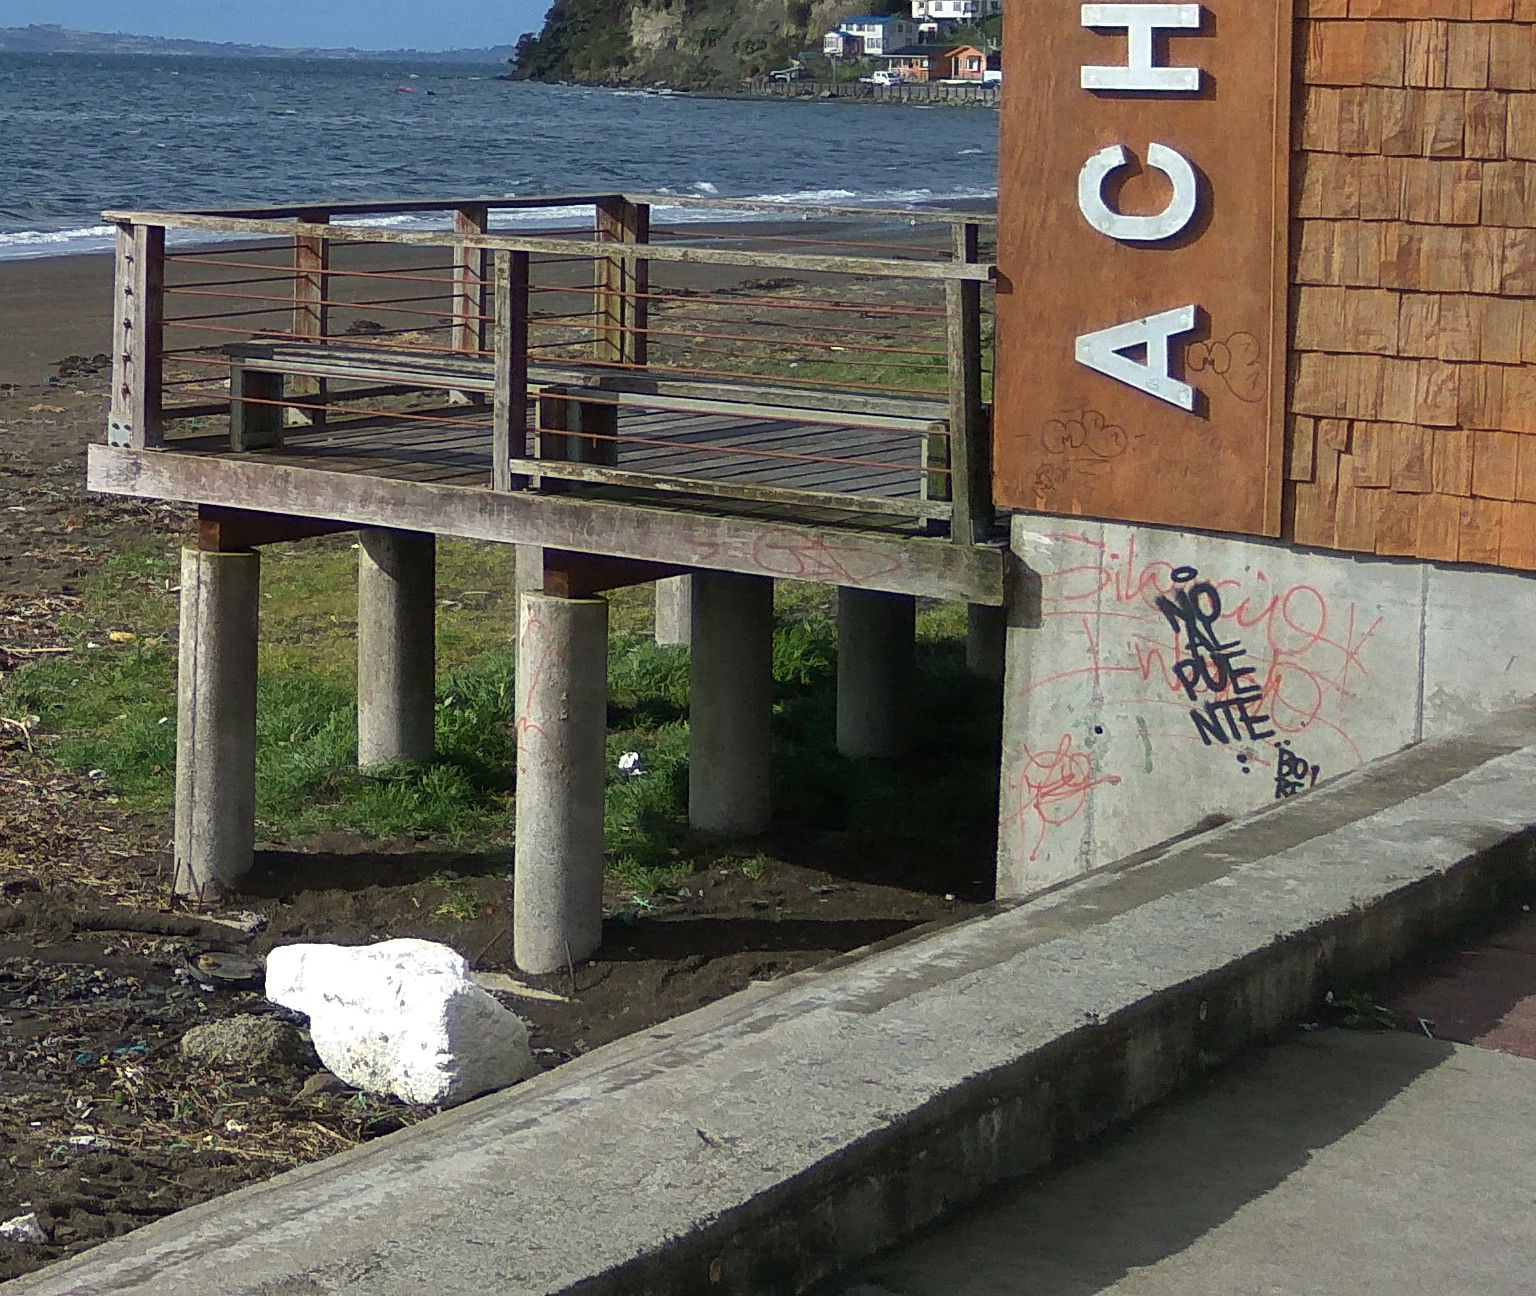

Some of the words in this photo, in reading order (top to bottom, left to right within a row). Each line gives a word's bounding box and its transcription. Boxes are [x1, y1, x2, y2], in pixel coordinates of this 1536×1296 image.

[1155, 581, 1221, 633] NO
[1172, 649, 1262, 702] PUE
[1189, 693, 1276, 746] NTE
